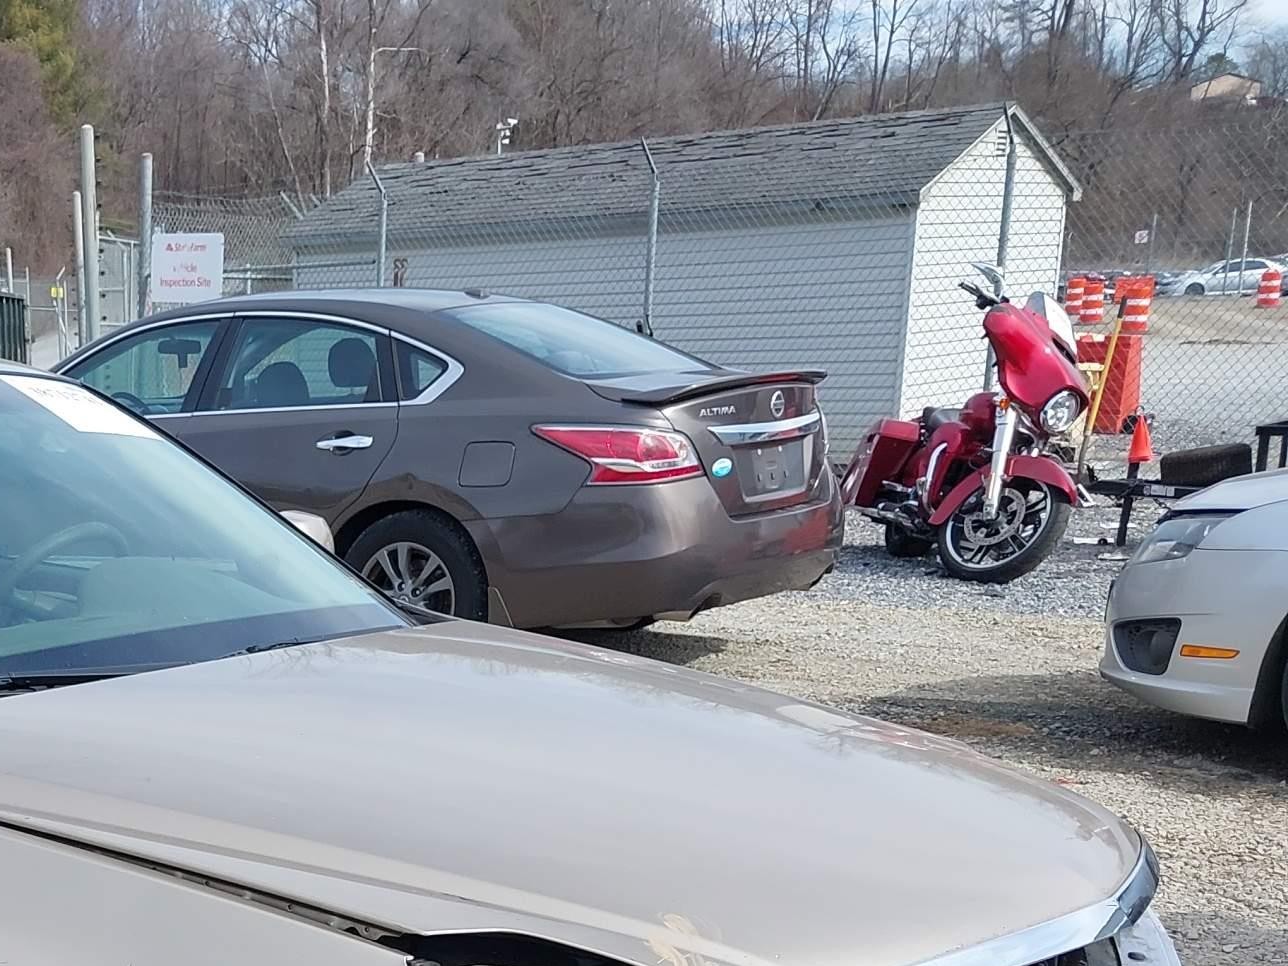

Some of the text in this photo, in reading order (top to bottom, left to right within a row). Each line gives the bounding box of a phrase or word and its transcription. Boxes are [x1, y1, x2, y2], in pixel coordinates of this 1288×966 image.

[160, 277, 211, 287] Inspection Site
[699, 405, 736, 417] ALTIMA
